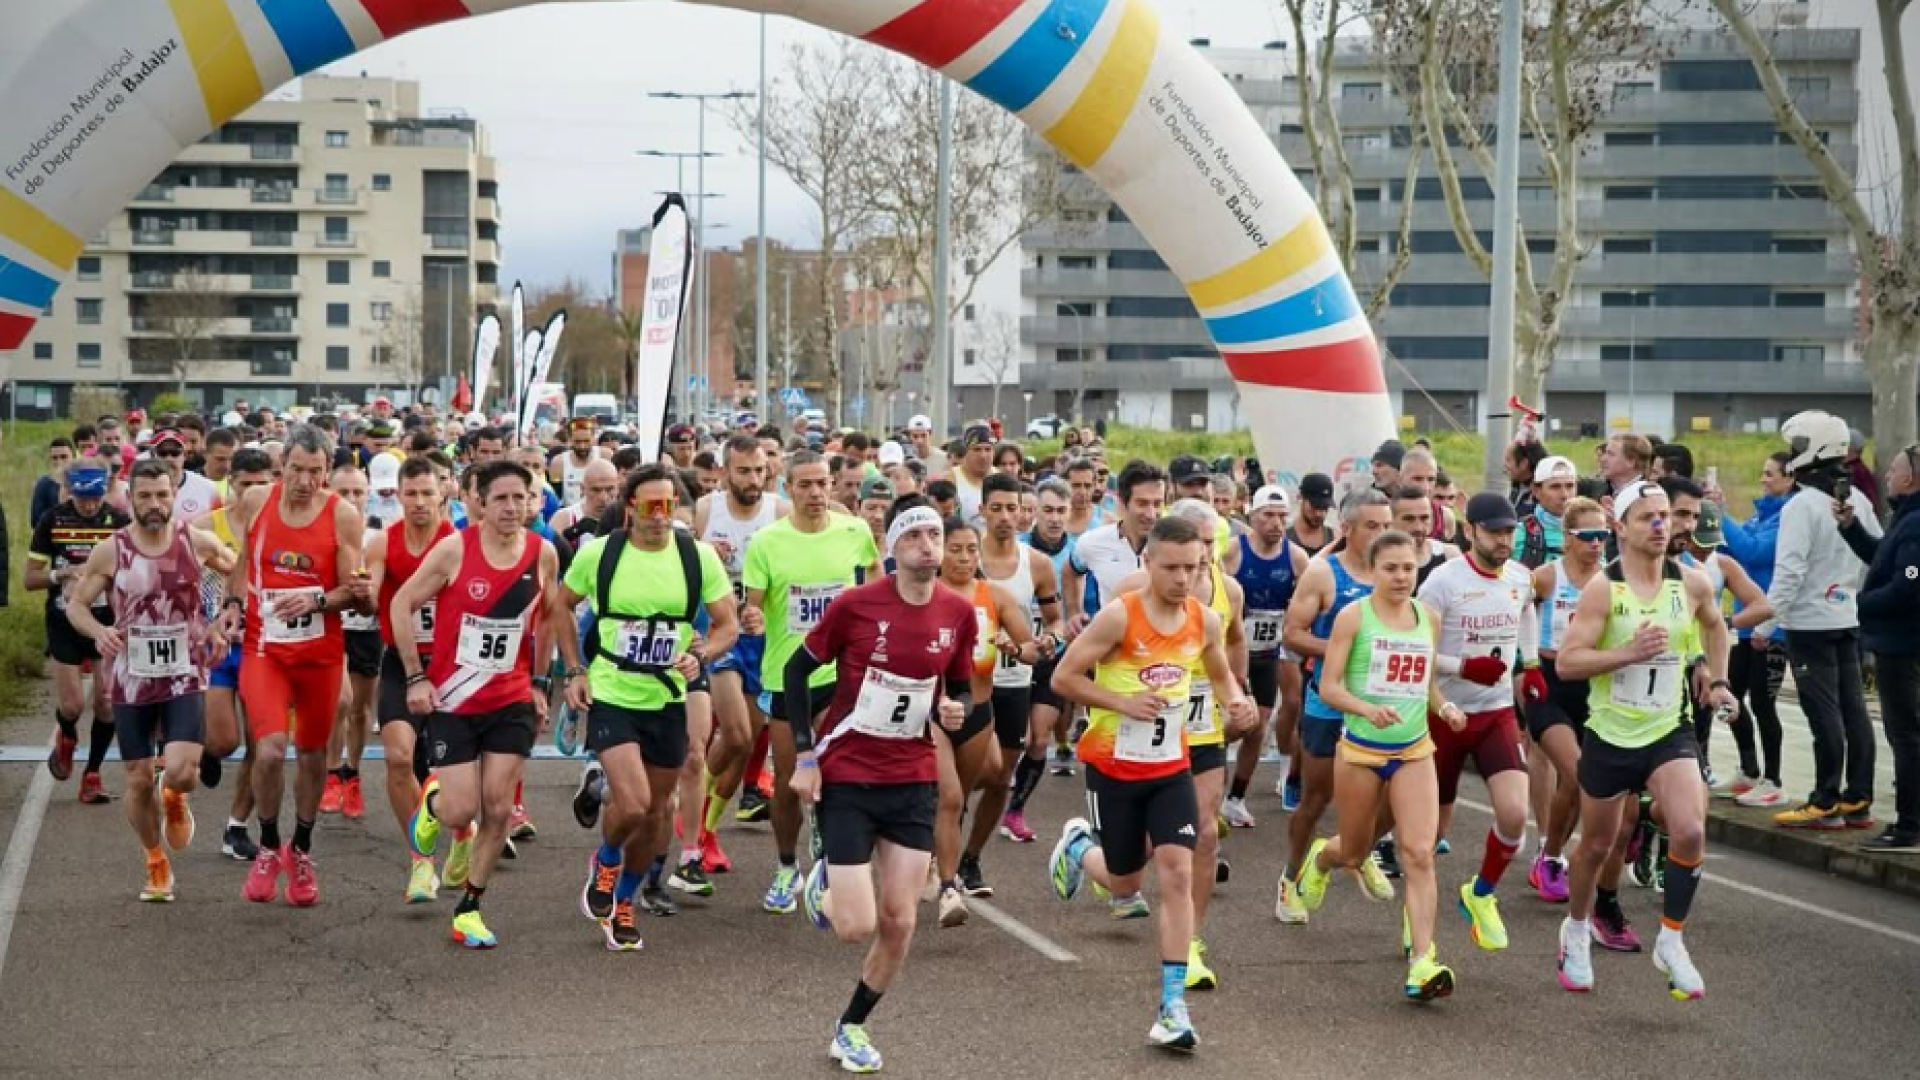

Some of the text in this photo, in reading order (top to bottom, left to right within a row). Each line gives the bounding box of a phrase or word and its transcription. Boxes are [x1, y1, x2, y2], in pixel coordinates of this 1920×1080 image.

[70, 48, 134, 114] Municipal
[24, 38, 178, 195] de Deportes de Badajoz
[1149, 97, 1268, 248] de Deportes de Badajoz
[1214, 147, 1264, 210] Municipal
[148, 639, 176, 665] 141
[479, 633, 508, 659] 36
[1386, 653, 1426, 683] 929
[1647, 668, 1657, 696] 1
[891, 694, 911, 723] 2
[1151, 717, 1166, 747] 3
